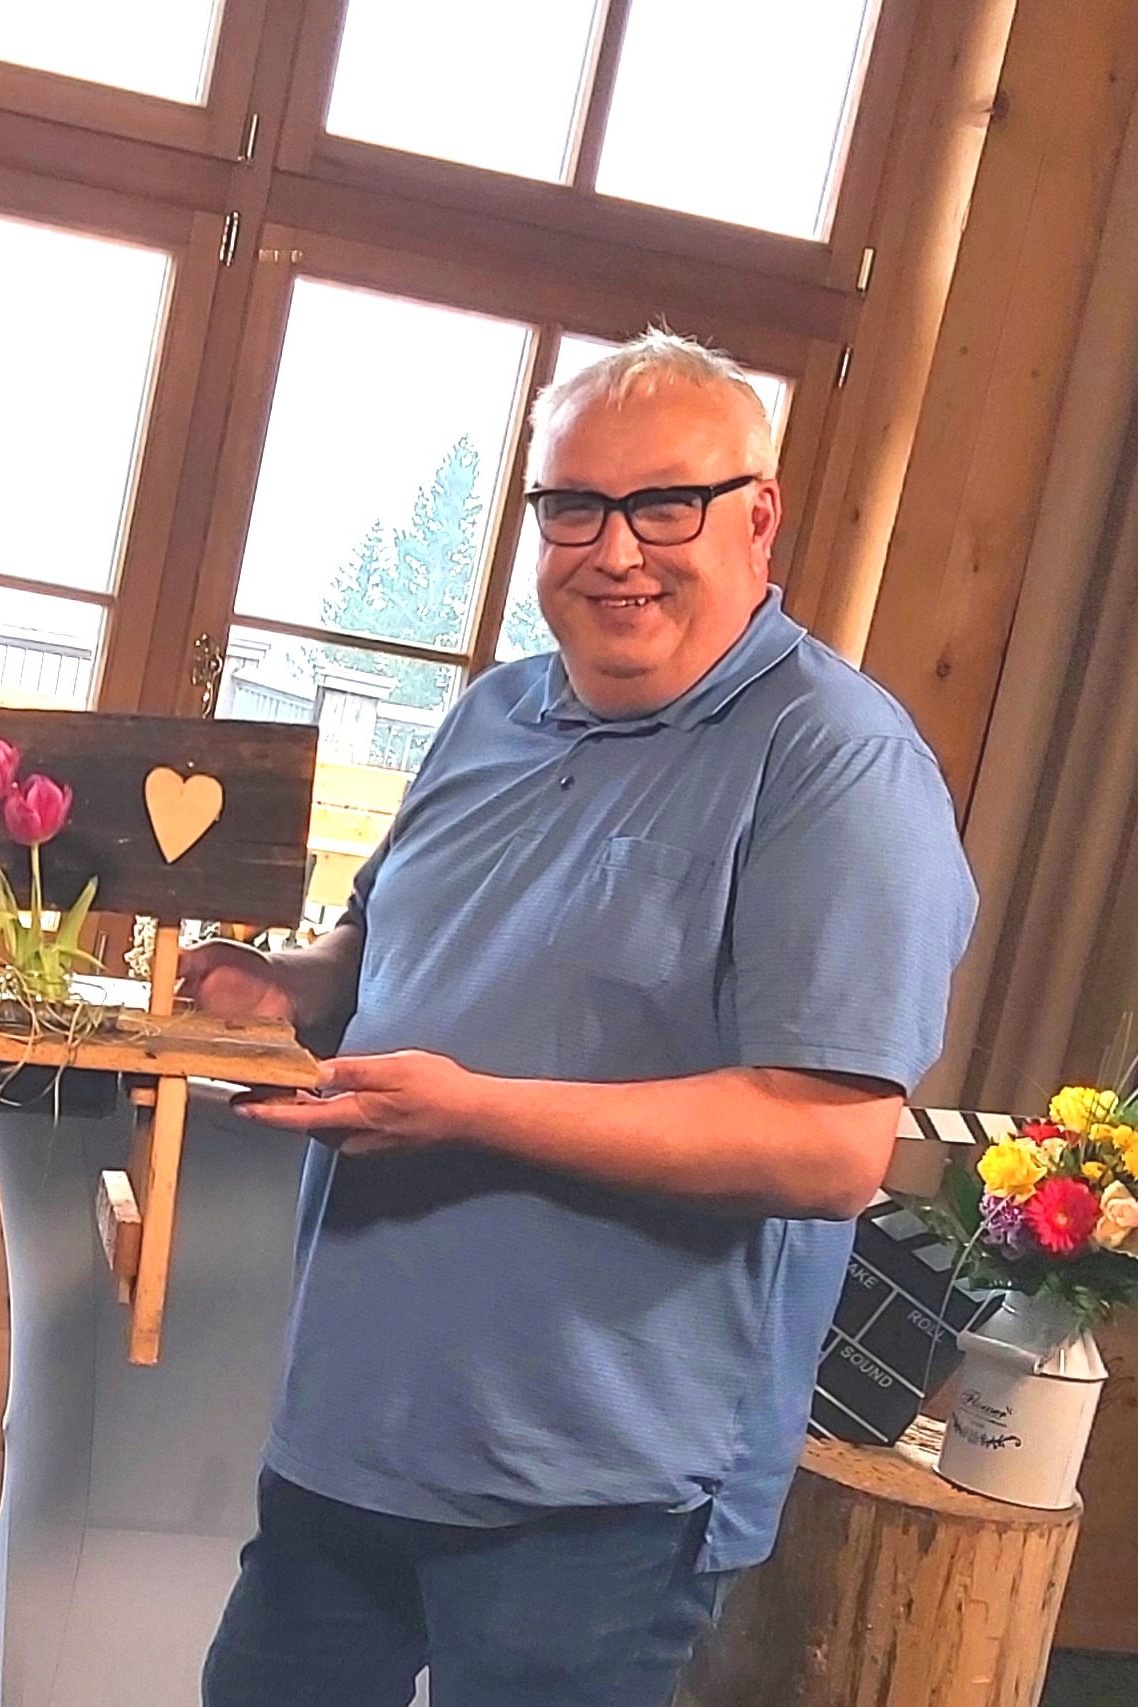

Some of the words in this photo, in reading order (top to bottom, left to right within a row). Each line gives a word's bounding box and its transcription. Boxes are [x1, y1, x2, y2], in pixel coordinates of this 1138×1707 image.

[847, 1262, 879, 1289] AKE
[906, 1309, 944, 1343] ROLL
[840, 1345, 893, 1388] SOUND
